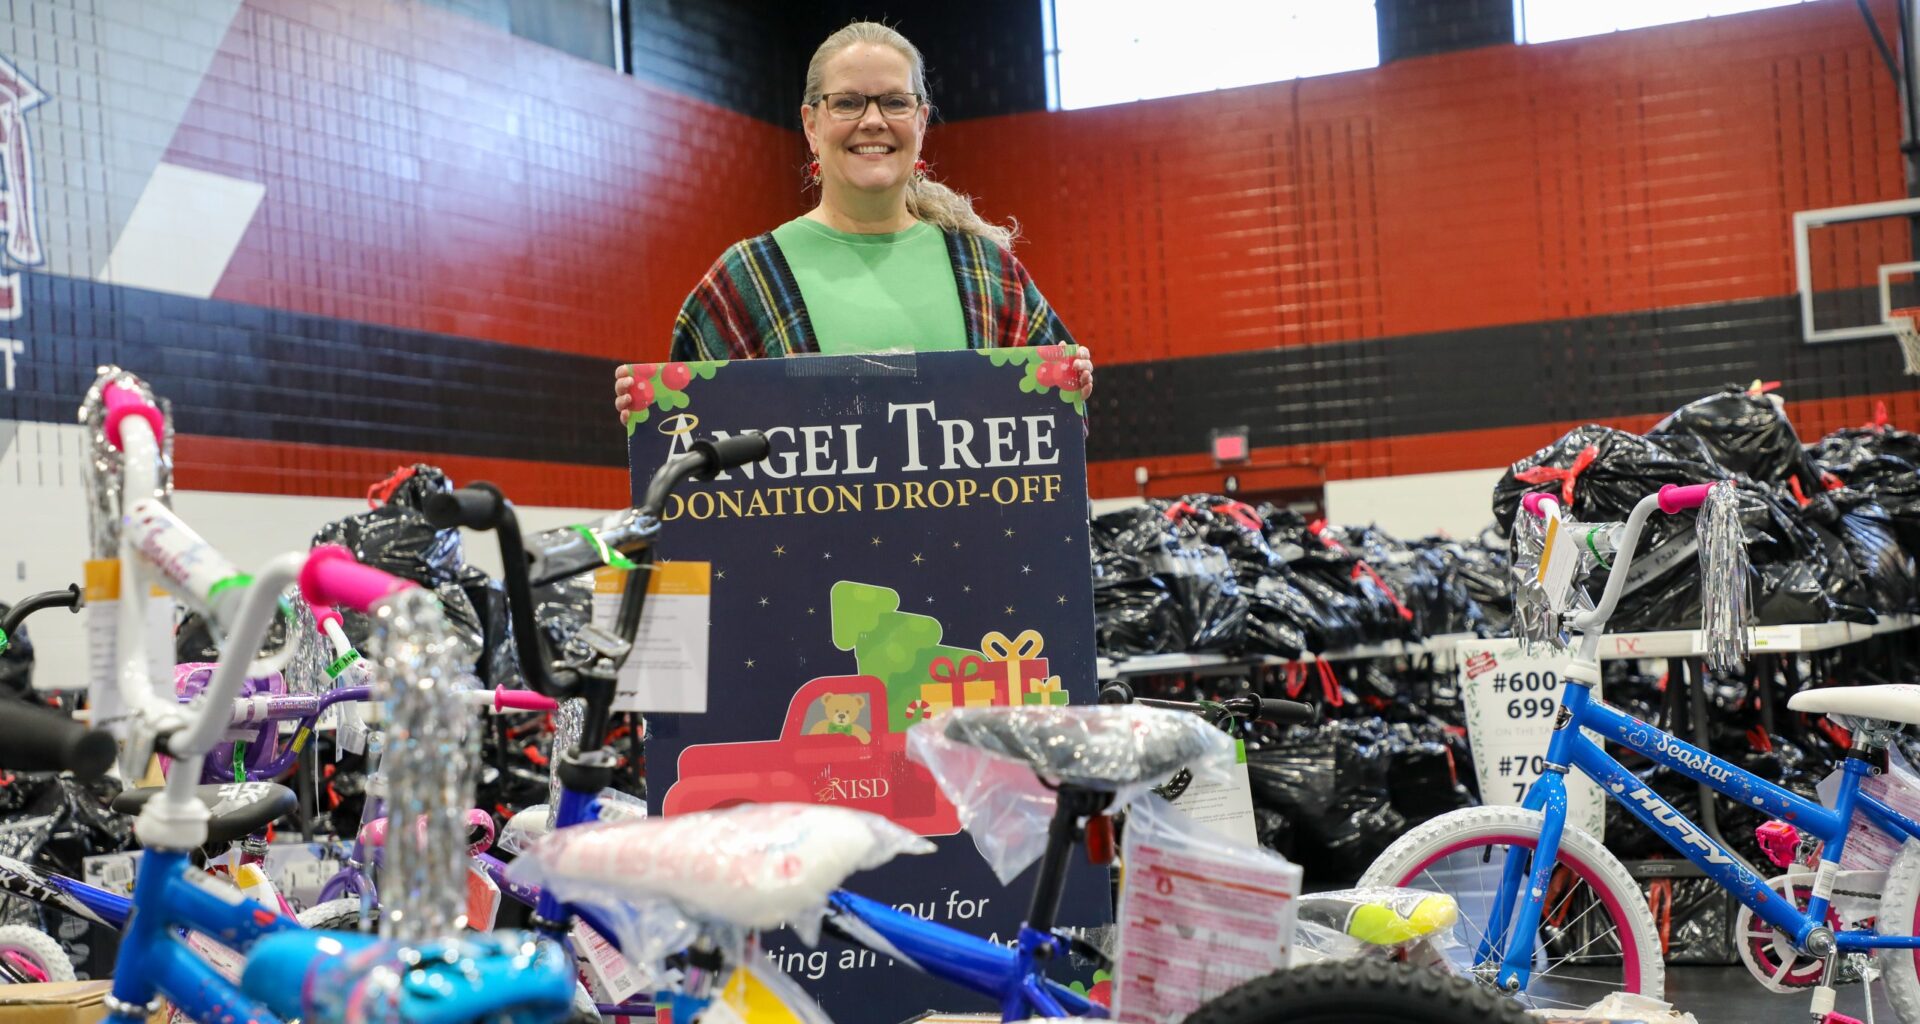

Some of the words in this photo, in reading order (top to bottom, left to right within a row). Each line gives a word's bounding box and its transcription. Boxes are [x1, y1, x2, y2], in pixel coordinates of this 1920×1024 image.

[887, 400, 1061, 472] TREE
[662, 484, 863, 521] DONATION
[874, 474, 1062, 511] DROP-OFF
[1507, 698, 1555, 719] 699
[1657, 734, 1733, 783] Seastar
[831, 777, 889, 800] NISD
[1629, 788, 1736, 864] HUFFY
[891, 902, 936, 921] ou
[946, 890, 990, 919] for
